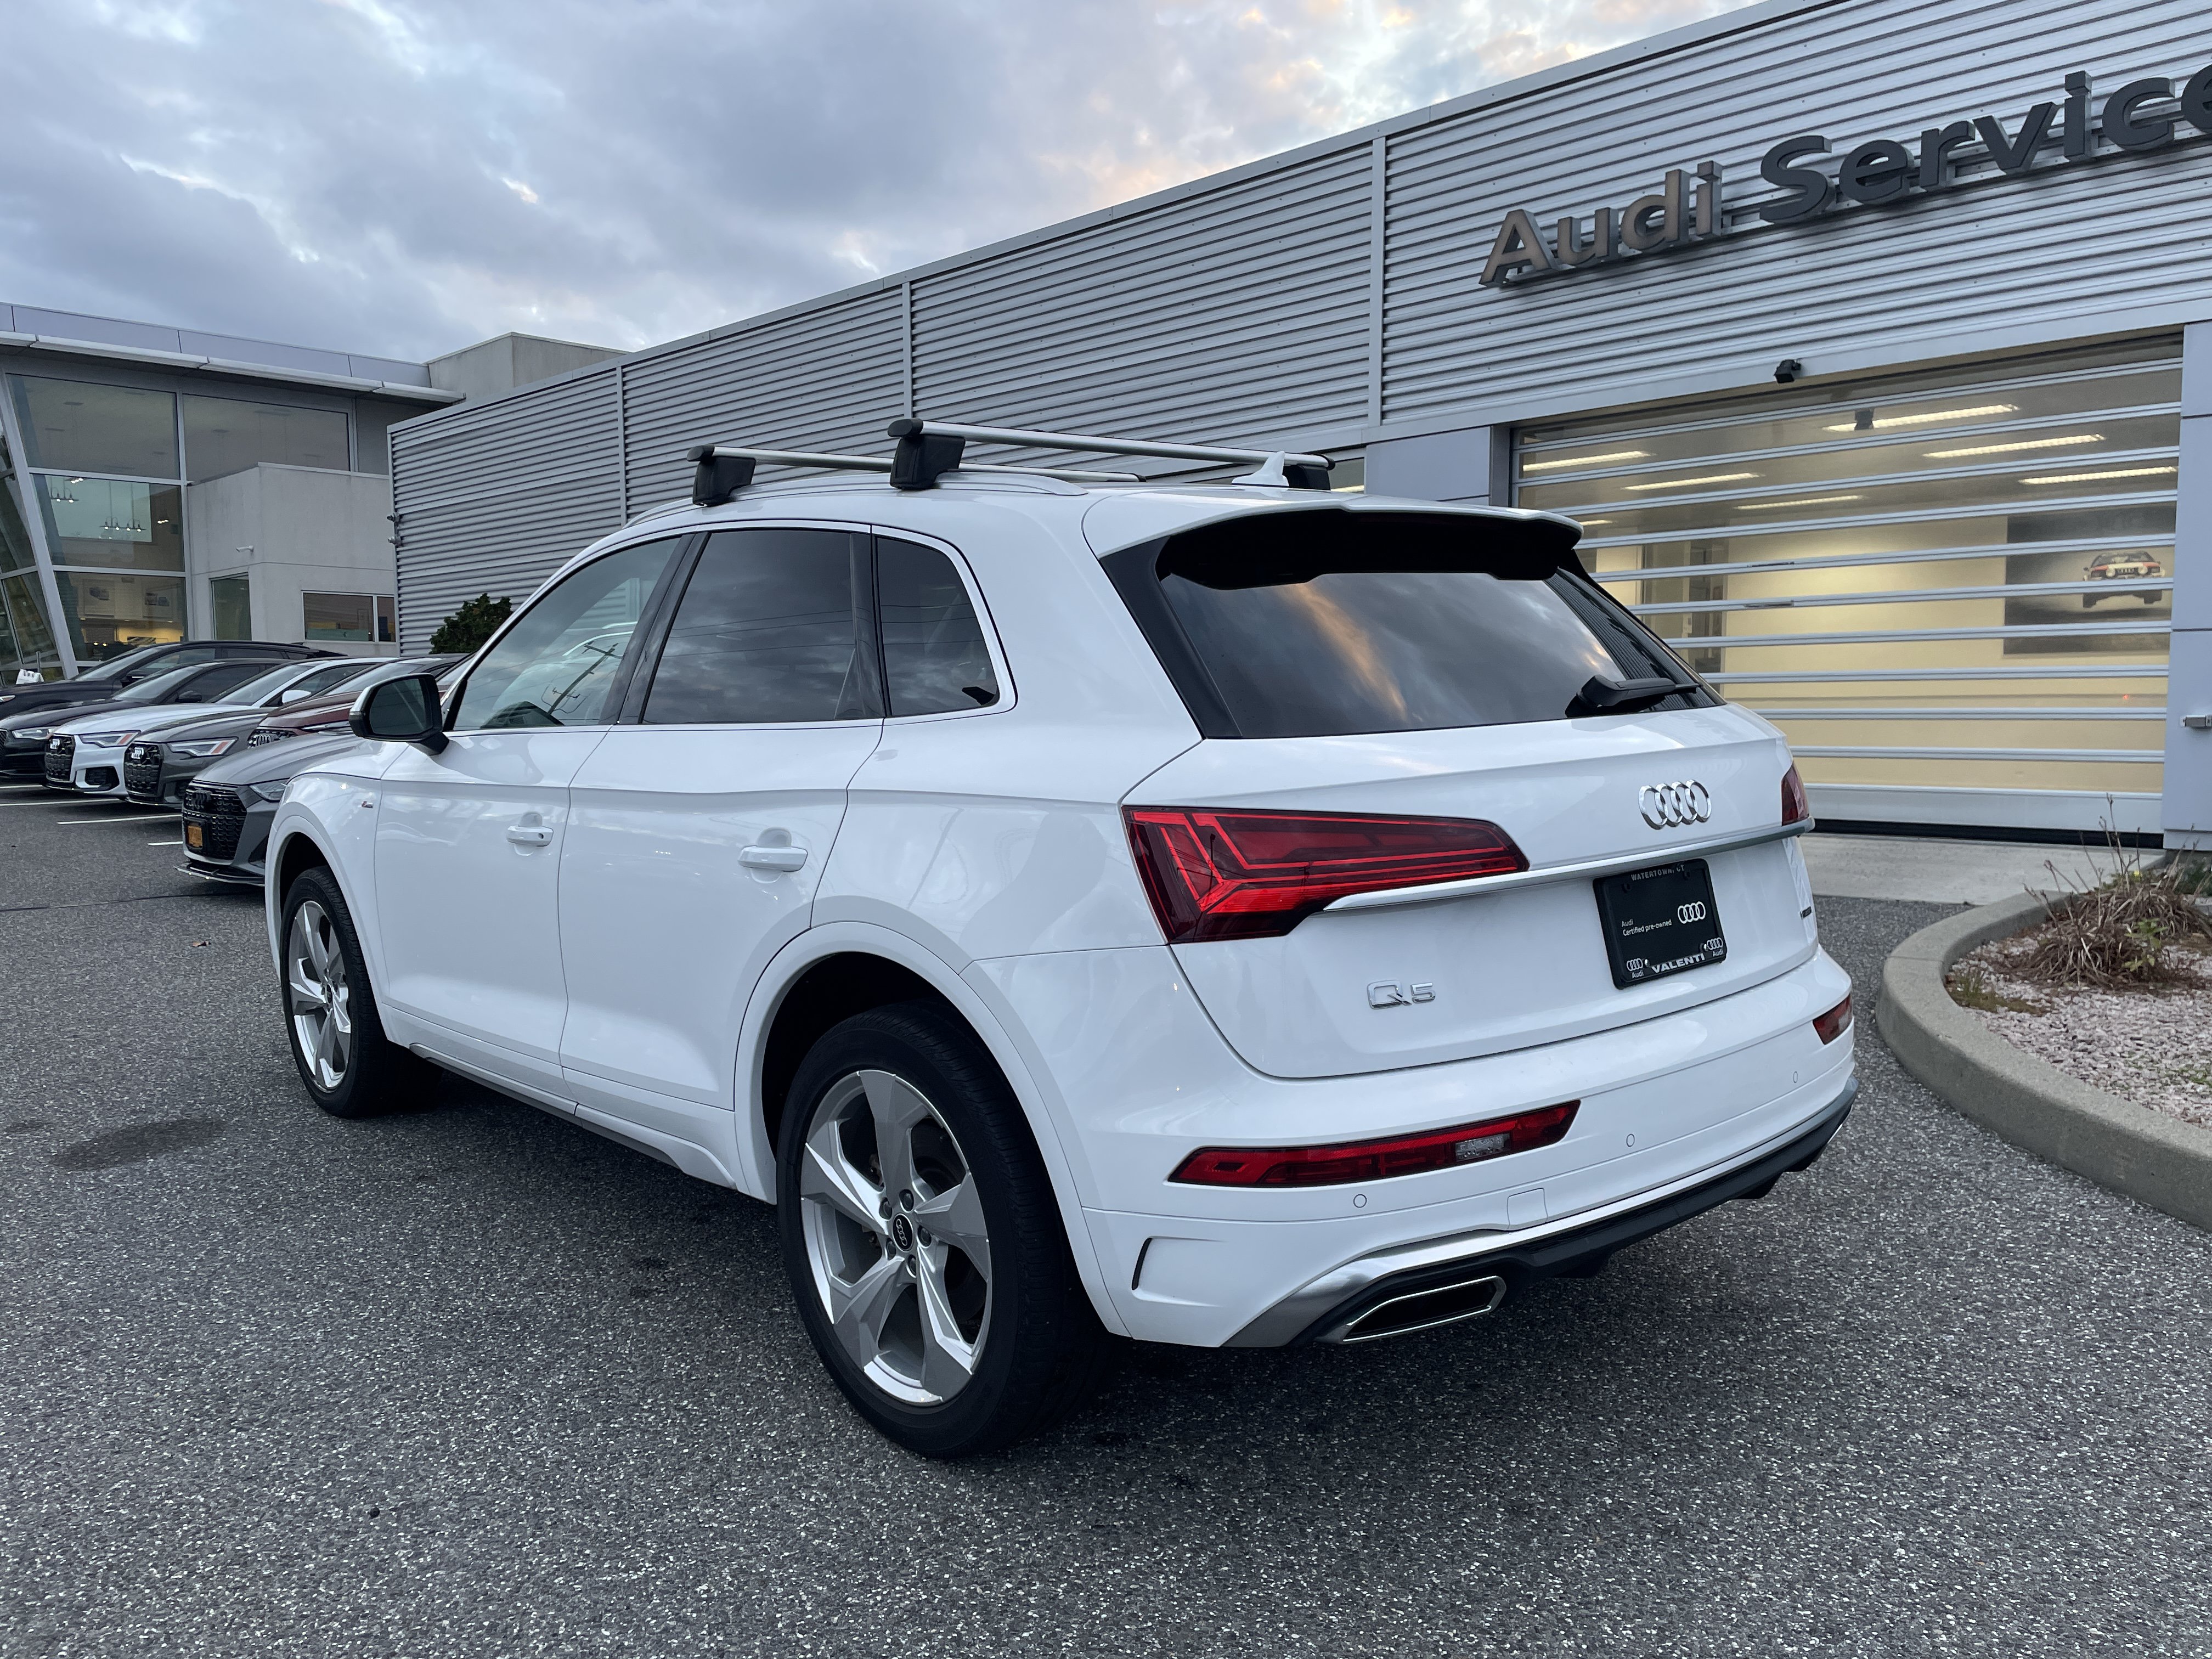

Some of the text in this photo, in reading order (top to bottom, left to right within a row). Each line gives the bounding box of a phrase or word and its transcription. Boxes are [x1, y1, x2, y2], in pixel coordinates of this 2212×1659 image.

[1479, 161, 1722, 286] Audi
[1621, 918, 1634, 927] Audi
[1623, 919, 1672, 936] Certified pre-owned
[1651, 953, 1705, 973] VALENTI
[1632, 970, 1644, 979] Audi
[1367, 979, 1436, 1009] Q5
